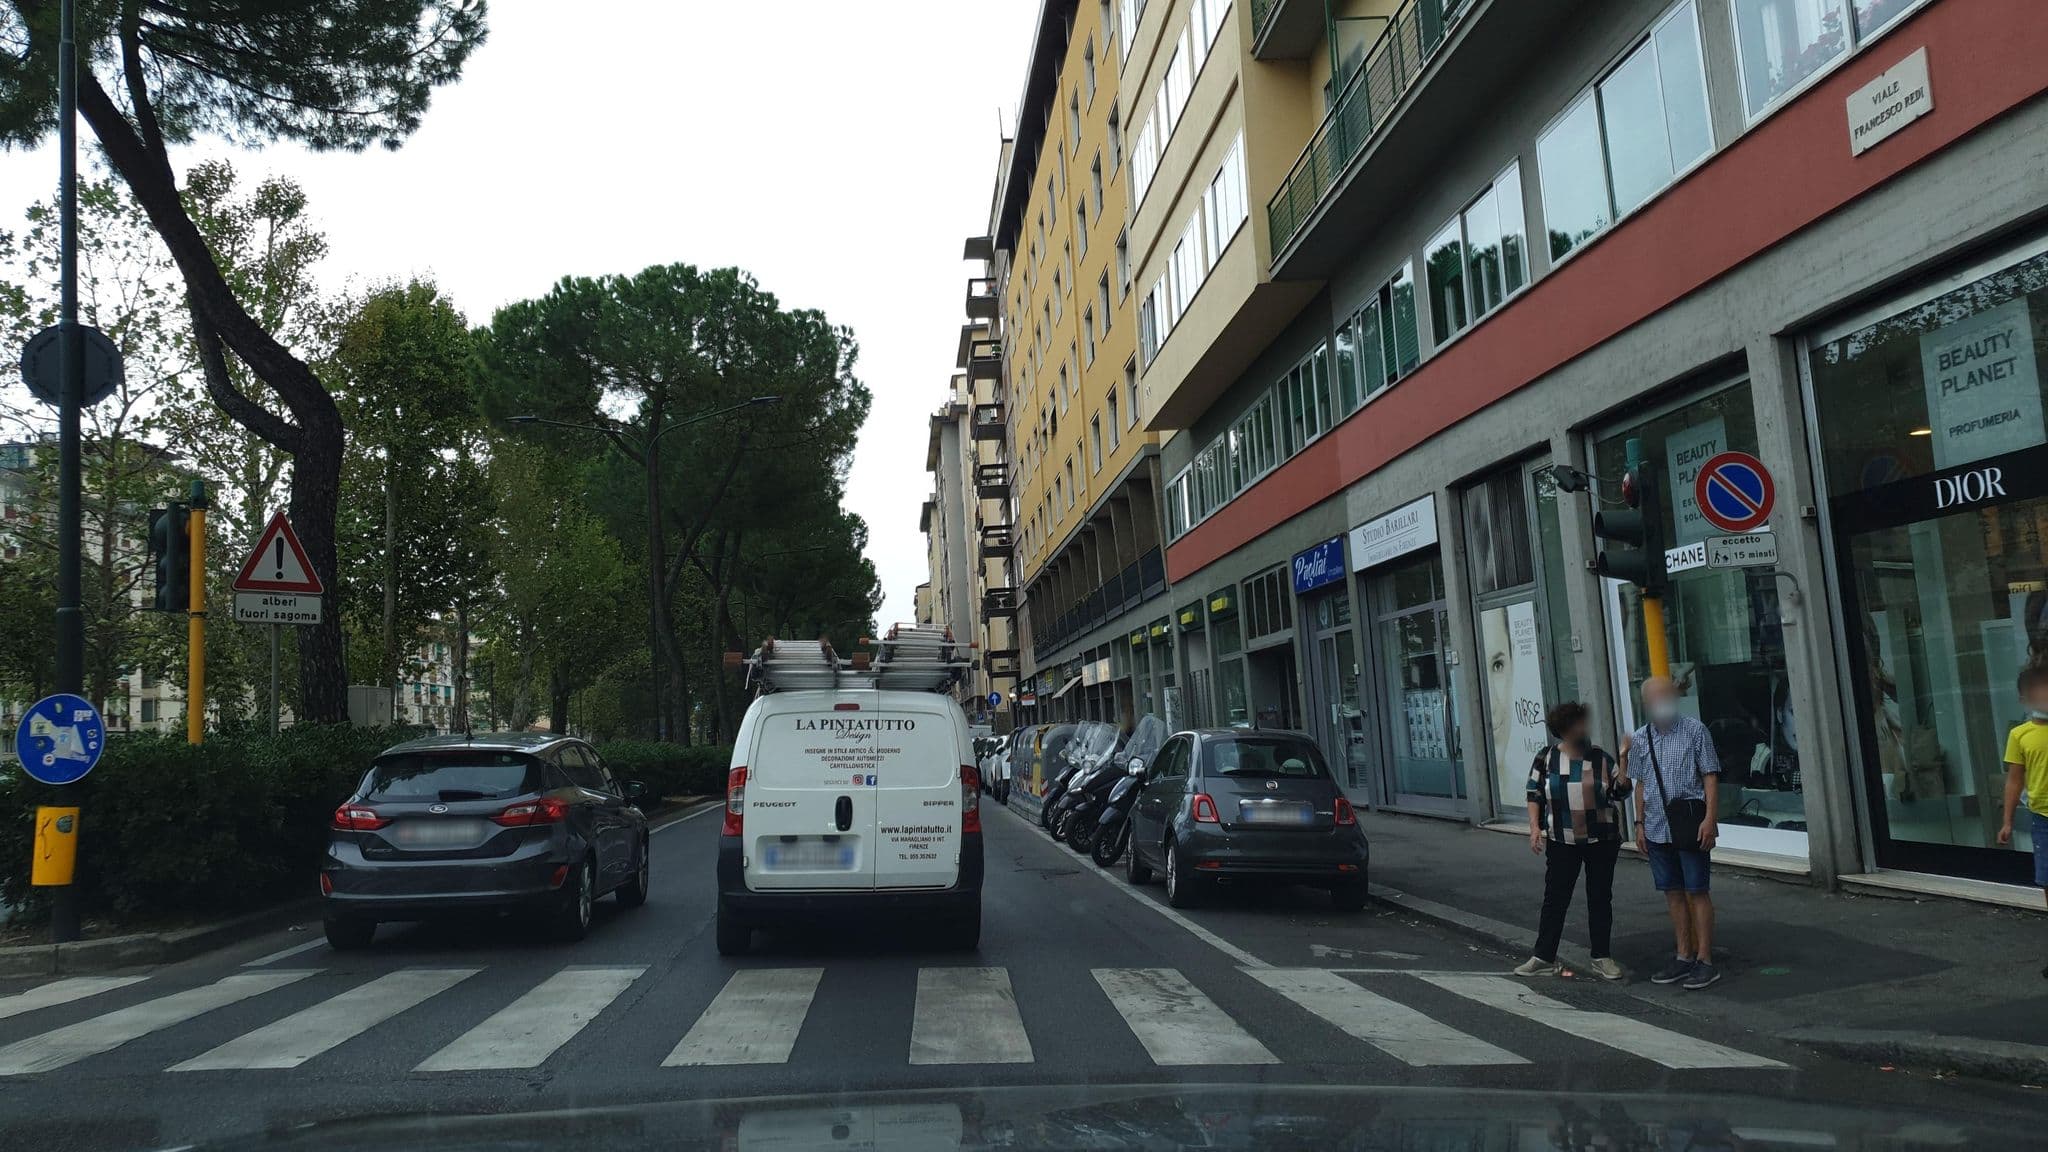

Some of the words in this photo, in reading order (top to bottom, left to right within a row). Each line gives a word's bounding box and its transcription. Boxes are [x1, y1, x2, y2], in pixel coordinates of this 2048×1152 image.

[1872, 81, 1900, 105] VIALE
[1854, 101, 1903, 140] FRANCESCO
[1904, 86, 1925, 108] REDI
[1938, 329, 2013, 372] BEAUTY
[1940, 356, 2017, 397] PLANET
[1949, 408, 2021, 438] PROFUMERIA
[1676, 439, 1716, 466] BEAUTY
[1678, 466, 1700, 485] PLA
[1933, 467, 2007, 509] DIOR
[1362, 526, 1384, 545] STUDIO
[1722, 536, 1761, 546] eccetto
[1665, 547, 1704, 569] CHANE
[1733, 552, 1745, 560] 15
[1748, 550, 1776, 559] minuti
[262, 596, 297, 607] alberi
[240, 609, 269, 619] fuori
[274, 611, 317, 621] sagoma
[796, 719, 816, 730] LA
[819, 719, 915, 730] PINTATUTTO
[834, 729, 871, 744] Design
[880, 825, 952, 835] www.lapintatutto.it
